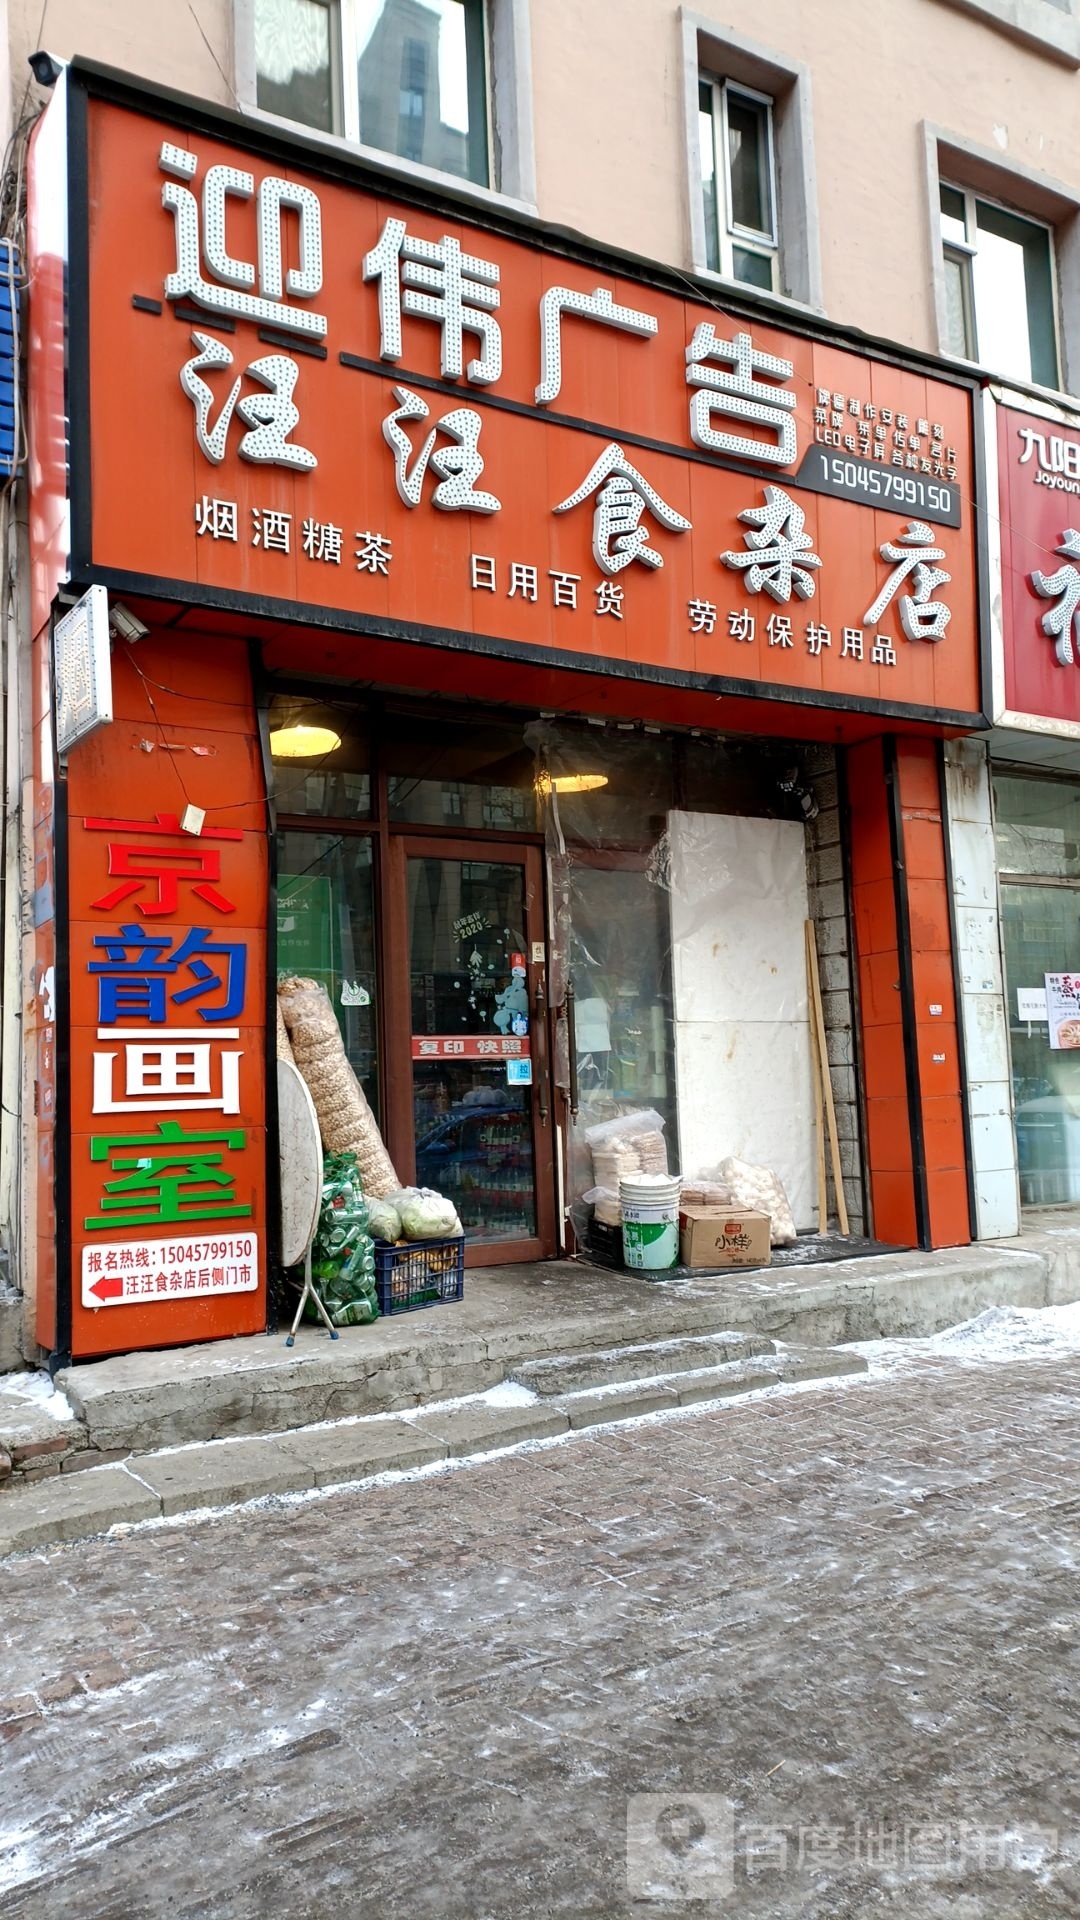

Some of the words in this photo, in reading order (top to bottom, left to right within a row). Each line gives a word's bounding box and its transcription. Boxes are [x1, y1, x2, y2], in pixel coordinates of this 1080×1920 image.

[158, 141, 798, 468] 迎伟广告
[179, 330, 953, 642] 汪汪食杂店
[820, 455, 951, 513] 15045799150
[1033, 470, 1080, 500] Joyoun
[195, 495, 393, 576] 烟酒糖茶
[471, 553, 624, 620] 日用百货
[688, 598, 897, 666] 劳动保护用品
[460, 921, 483, 939] 2020
[83, 812, 252, 1230] 京韵画室
[419, 1040, 464, 1055] 复印
[477, 1039, 521, 1054] 快照
[126, 1264, 252, 1295] 汪汪食杂店后侧门市
